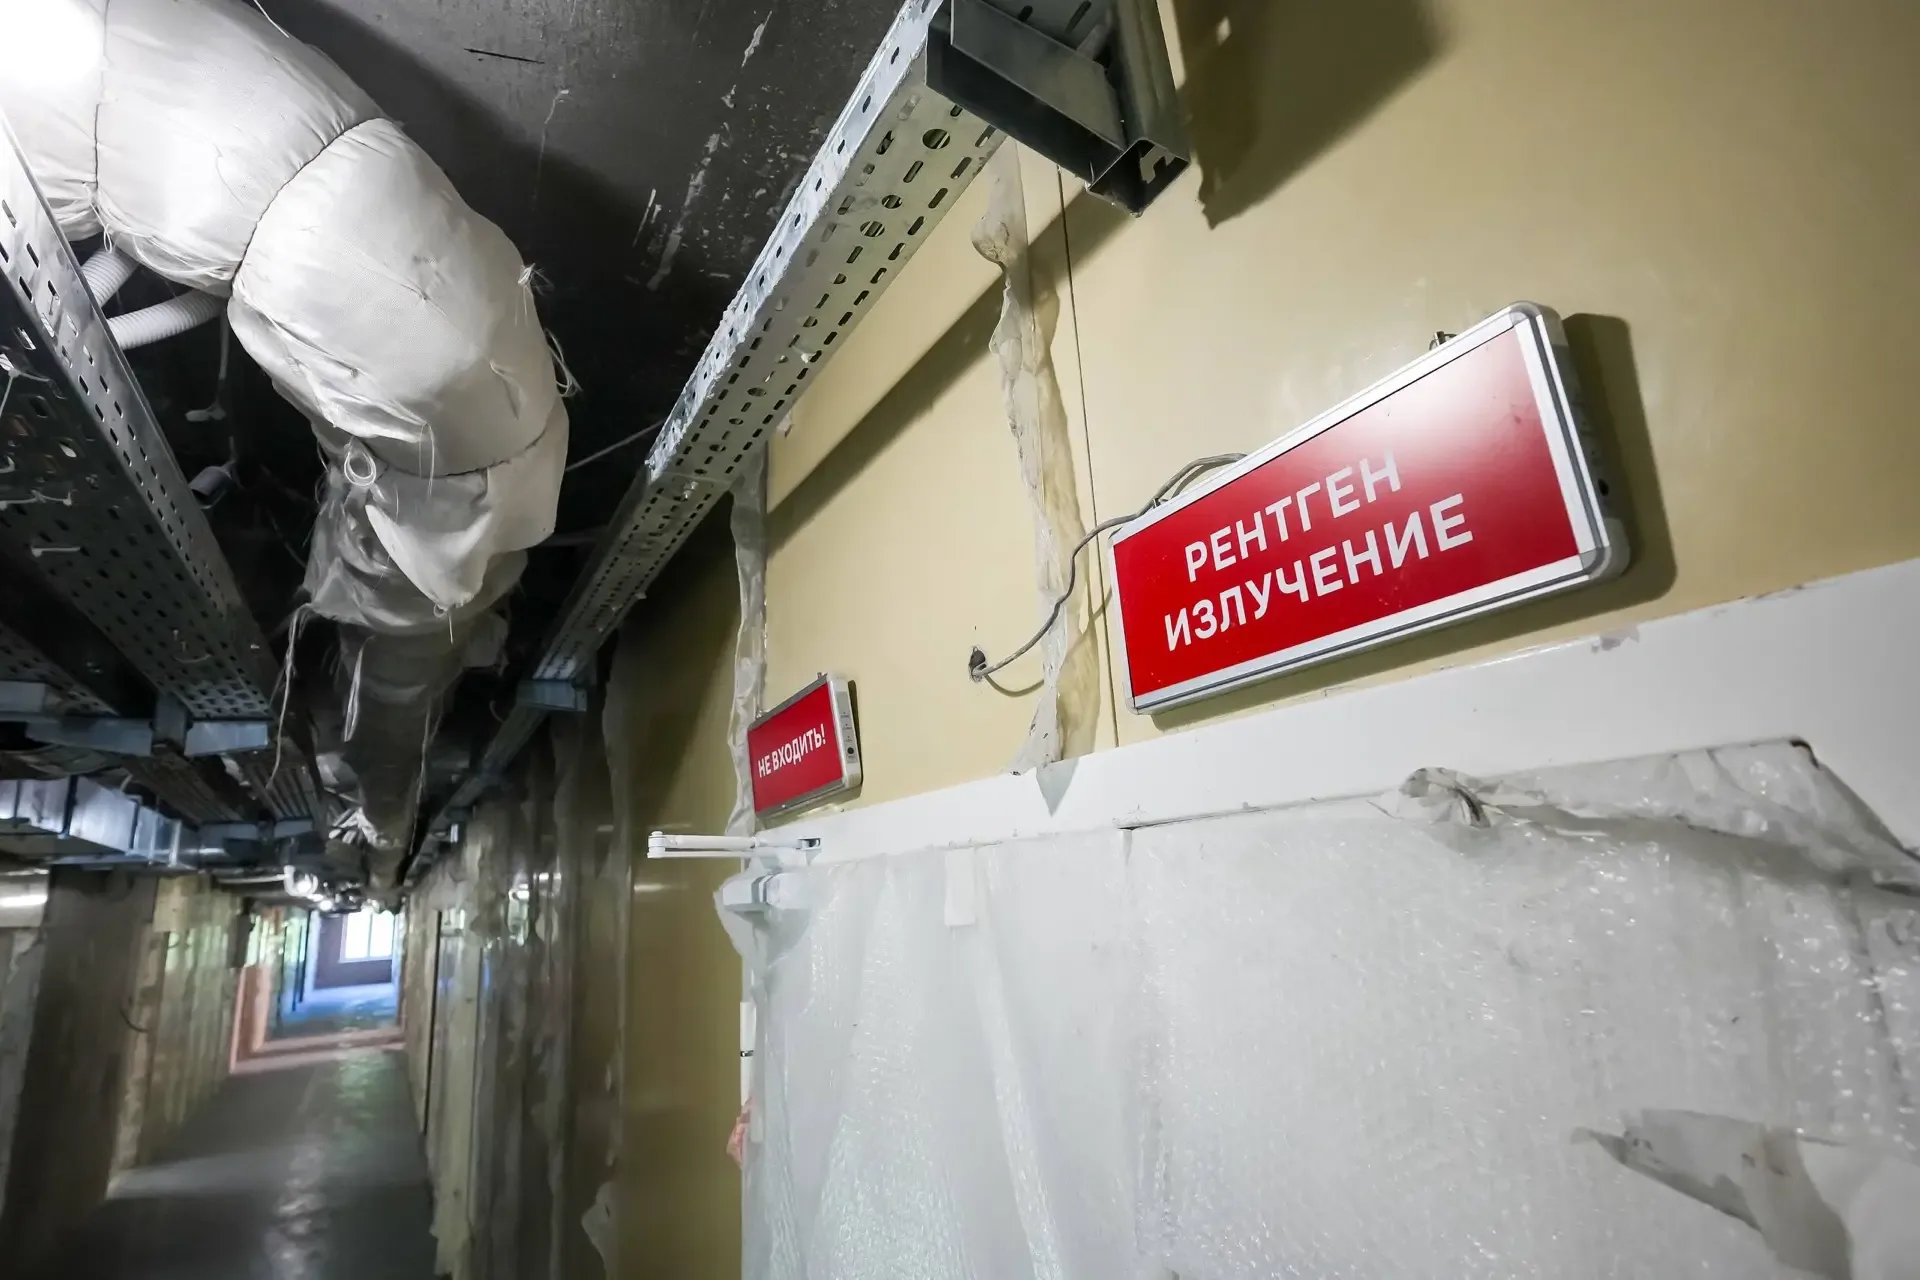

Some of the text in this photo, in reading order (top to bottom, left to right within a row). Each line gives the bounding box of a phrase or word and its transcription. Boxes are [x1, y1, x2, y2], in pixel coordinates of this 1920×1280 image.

[1164, 492, 1474, 651] ИЗЛУЧЕНИЕ
[1185, 449, 1402, 583] РЕНТГЕН
[757, 723, 826, 778] НЕ ВХОДИТЬ!
